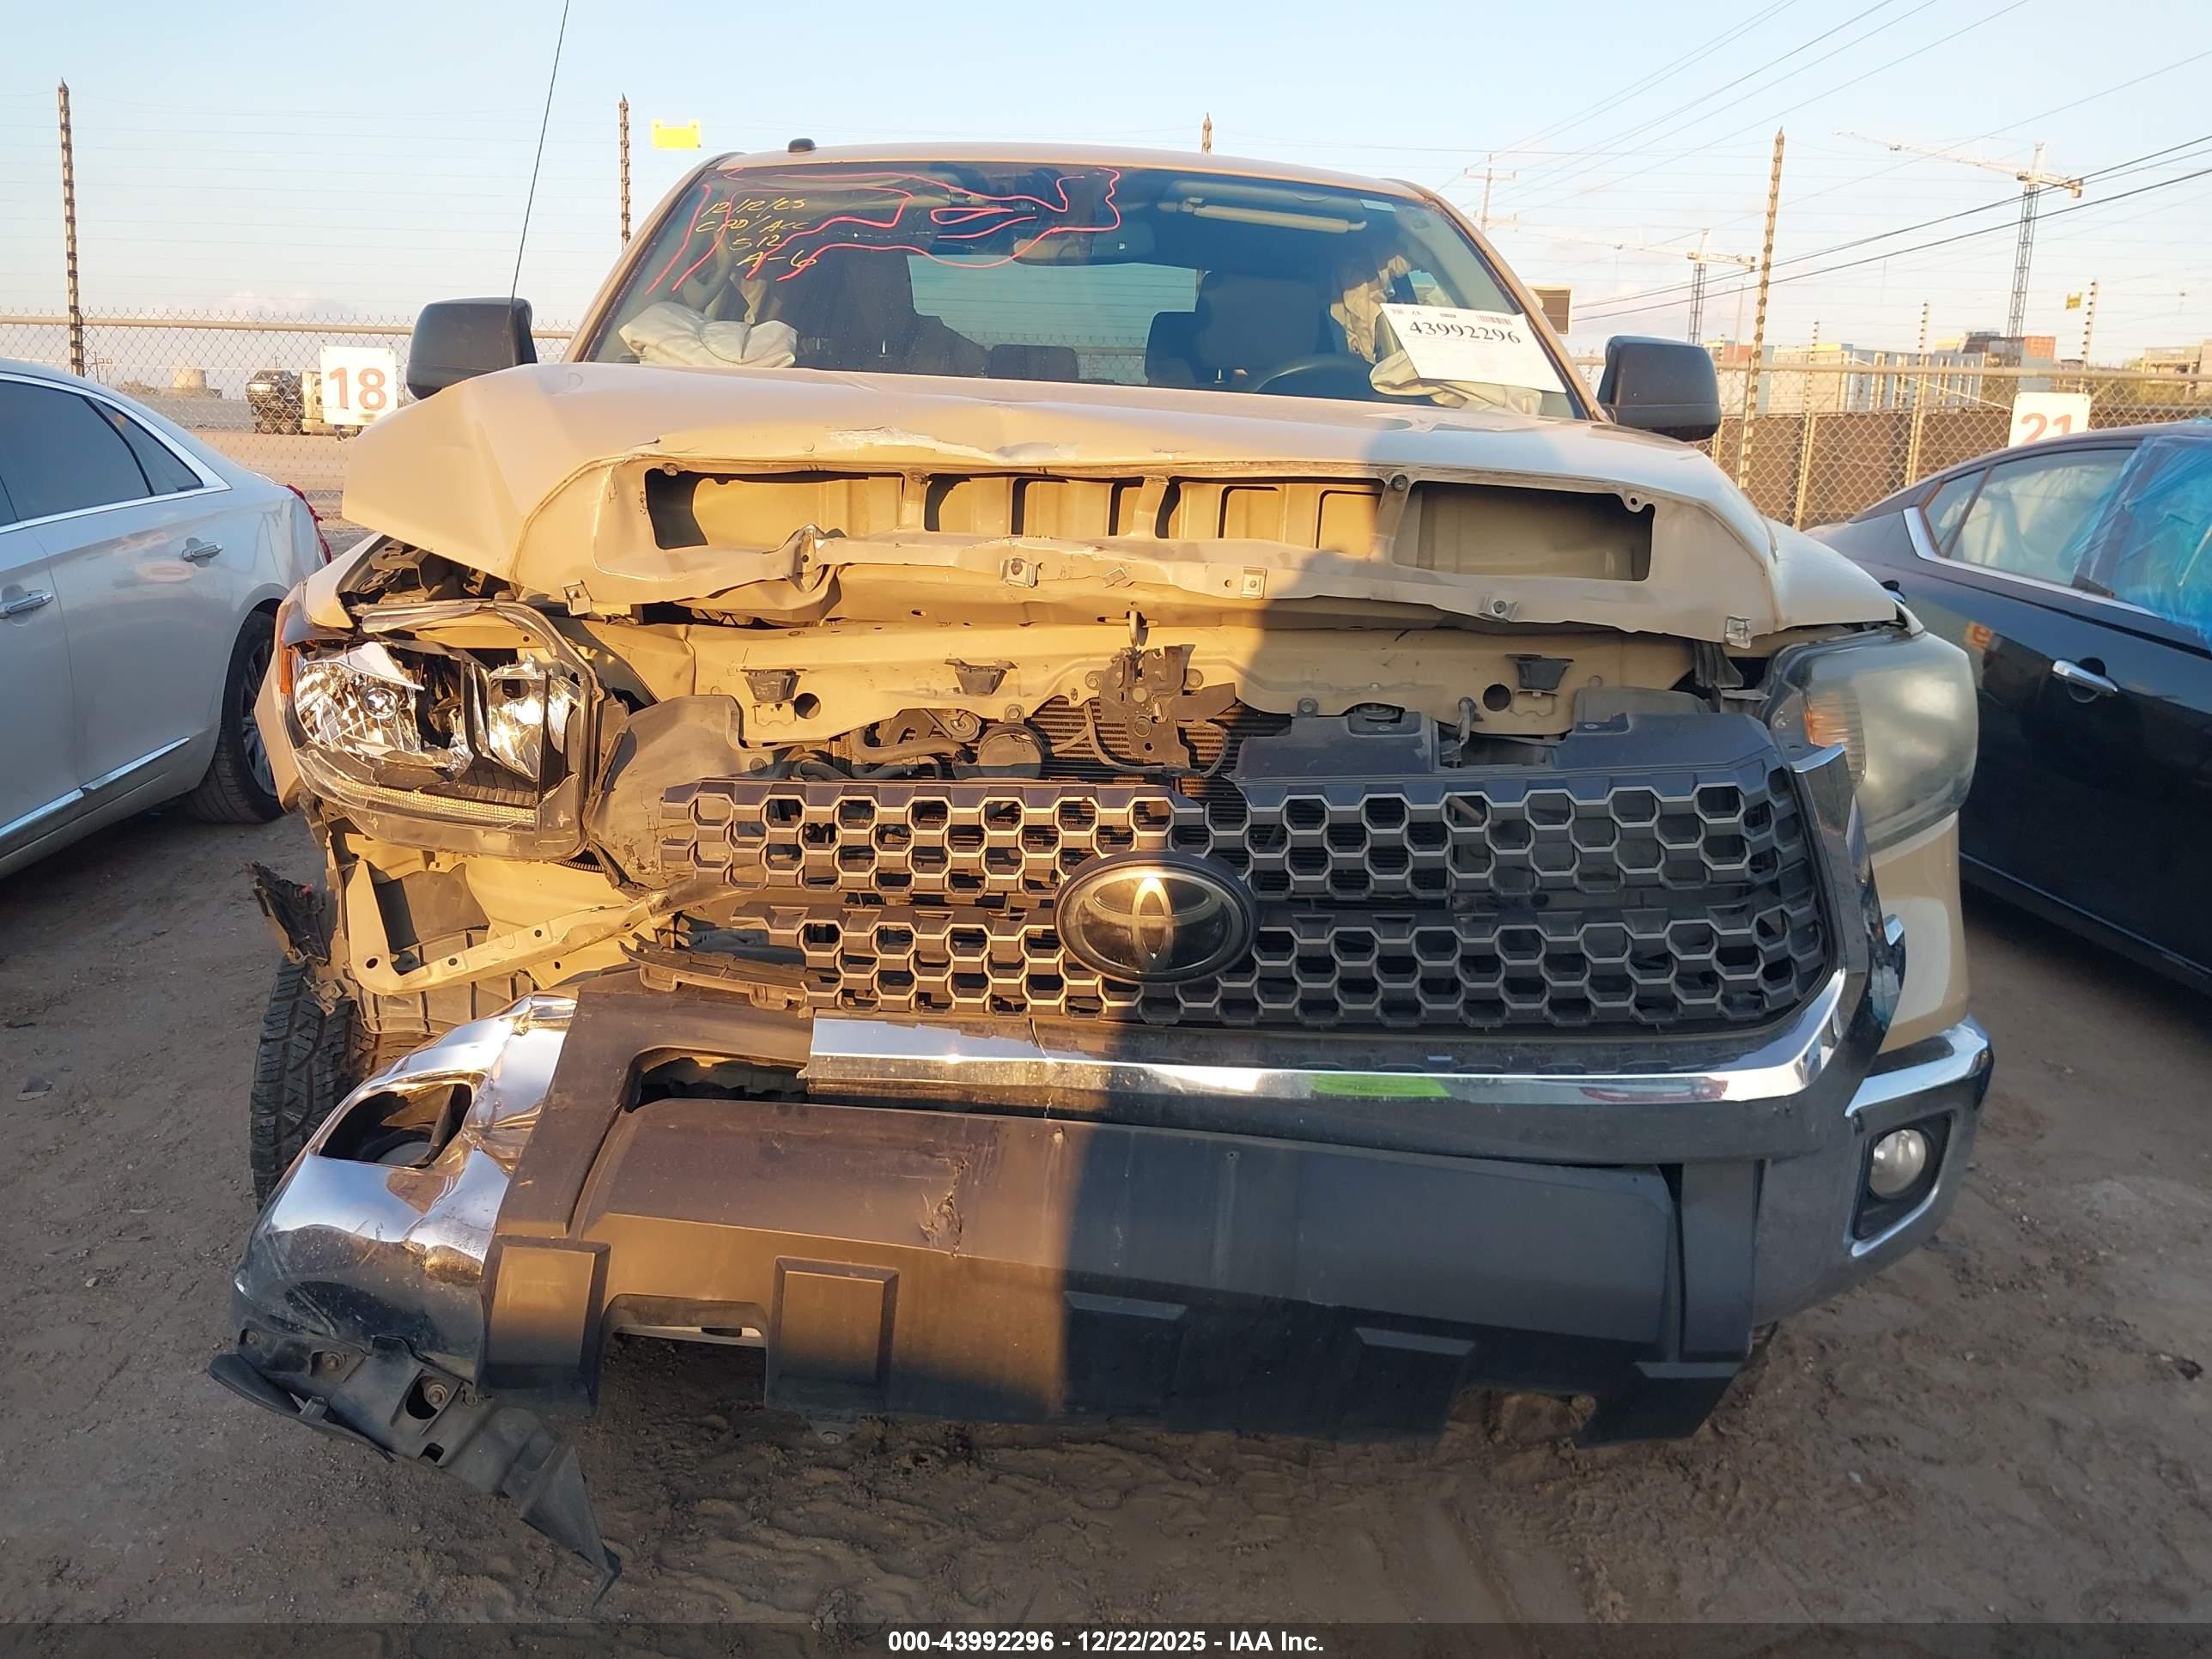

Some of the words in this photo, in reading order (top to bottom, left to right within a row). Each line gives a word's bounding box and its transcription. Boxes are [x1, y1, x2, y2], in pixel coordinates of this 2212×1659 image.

[728, 234, 786, 251] 512
[1409, 320, 1522, 344] 43992296
[328, 367, 387, 411] 18
[2020, 412, 2073, 444] 21
